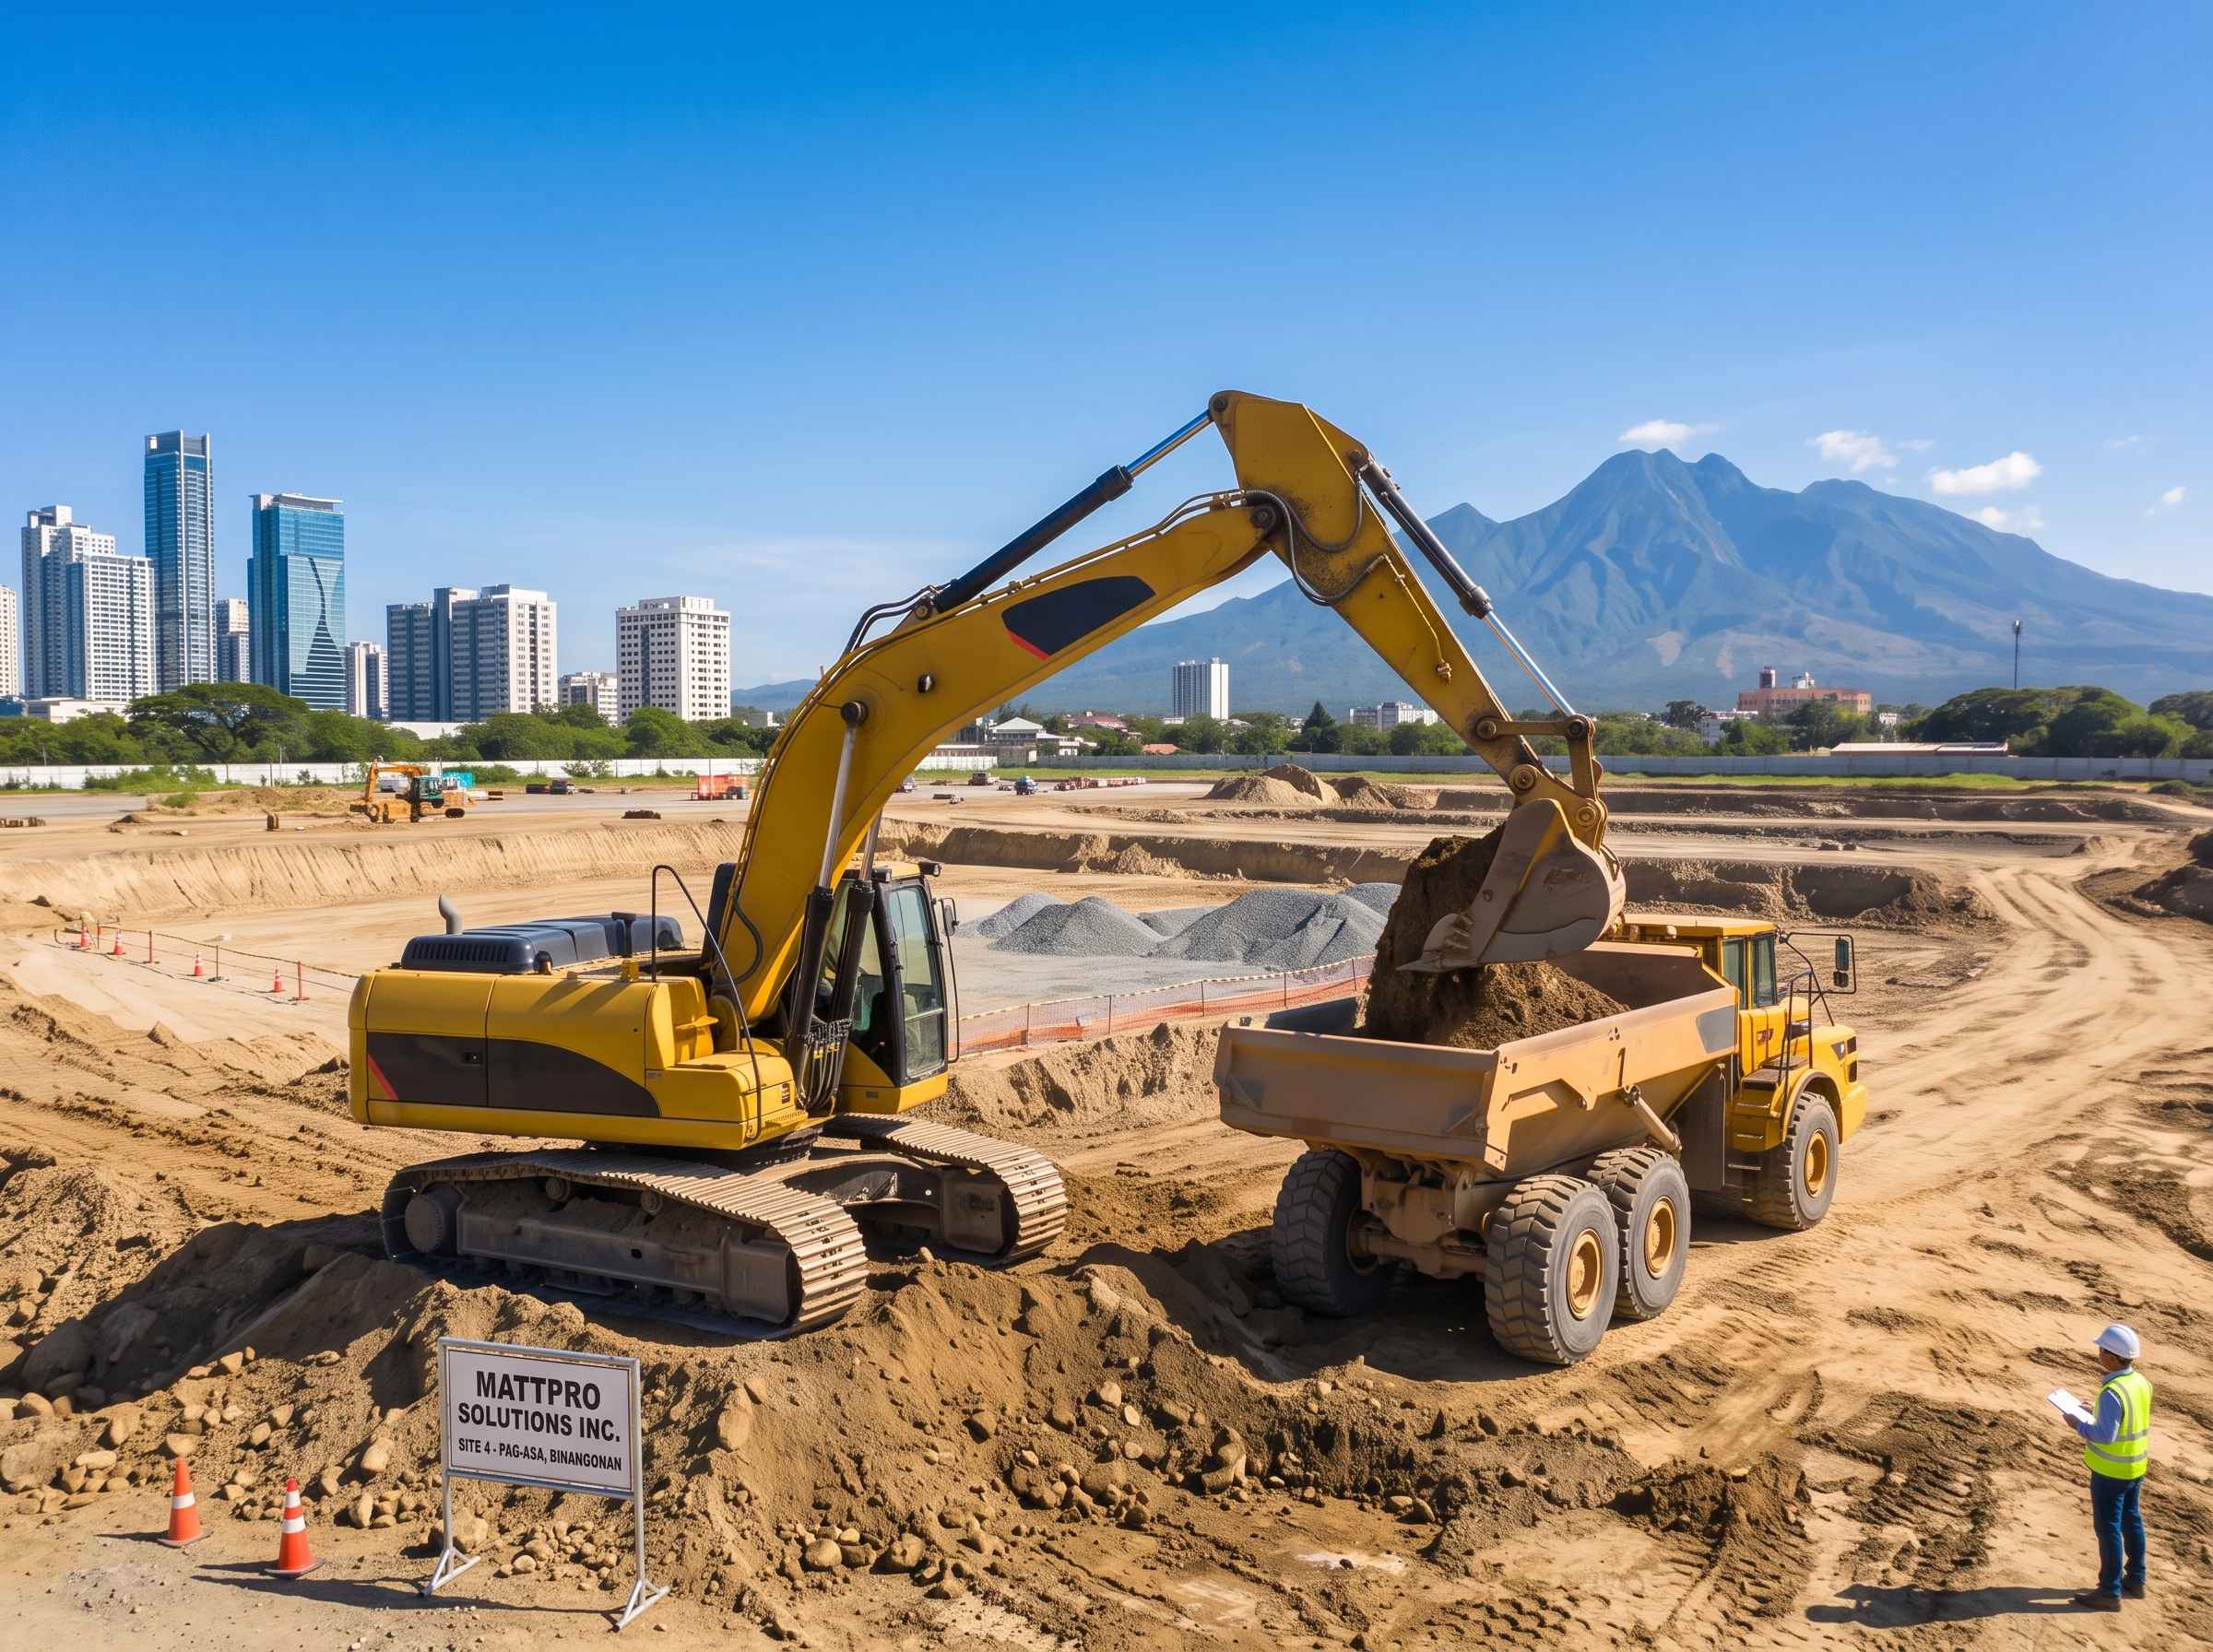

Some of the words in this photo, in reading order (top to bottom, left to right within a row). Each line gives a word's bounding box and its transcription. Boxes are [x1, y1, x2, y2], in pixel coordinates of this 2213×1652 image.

[476, 1370, 601, 1410] MATTPRO
[457, 1401, 573, 1436] SOLUTIONS
[579, 1416, 621, 1443] INC.
[458, 1437, 481, 1454] SITE
[484, 1440, 491, 1456] 4
[499, 1442, 548, 1465] PAG-ASA,
[550, 1448, 622, 1471] BINANGONAN
